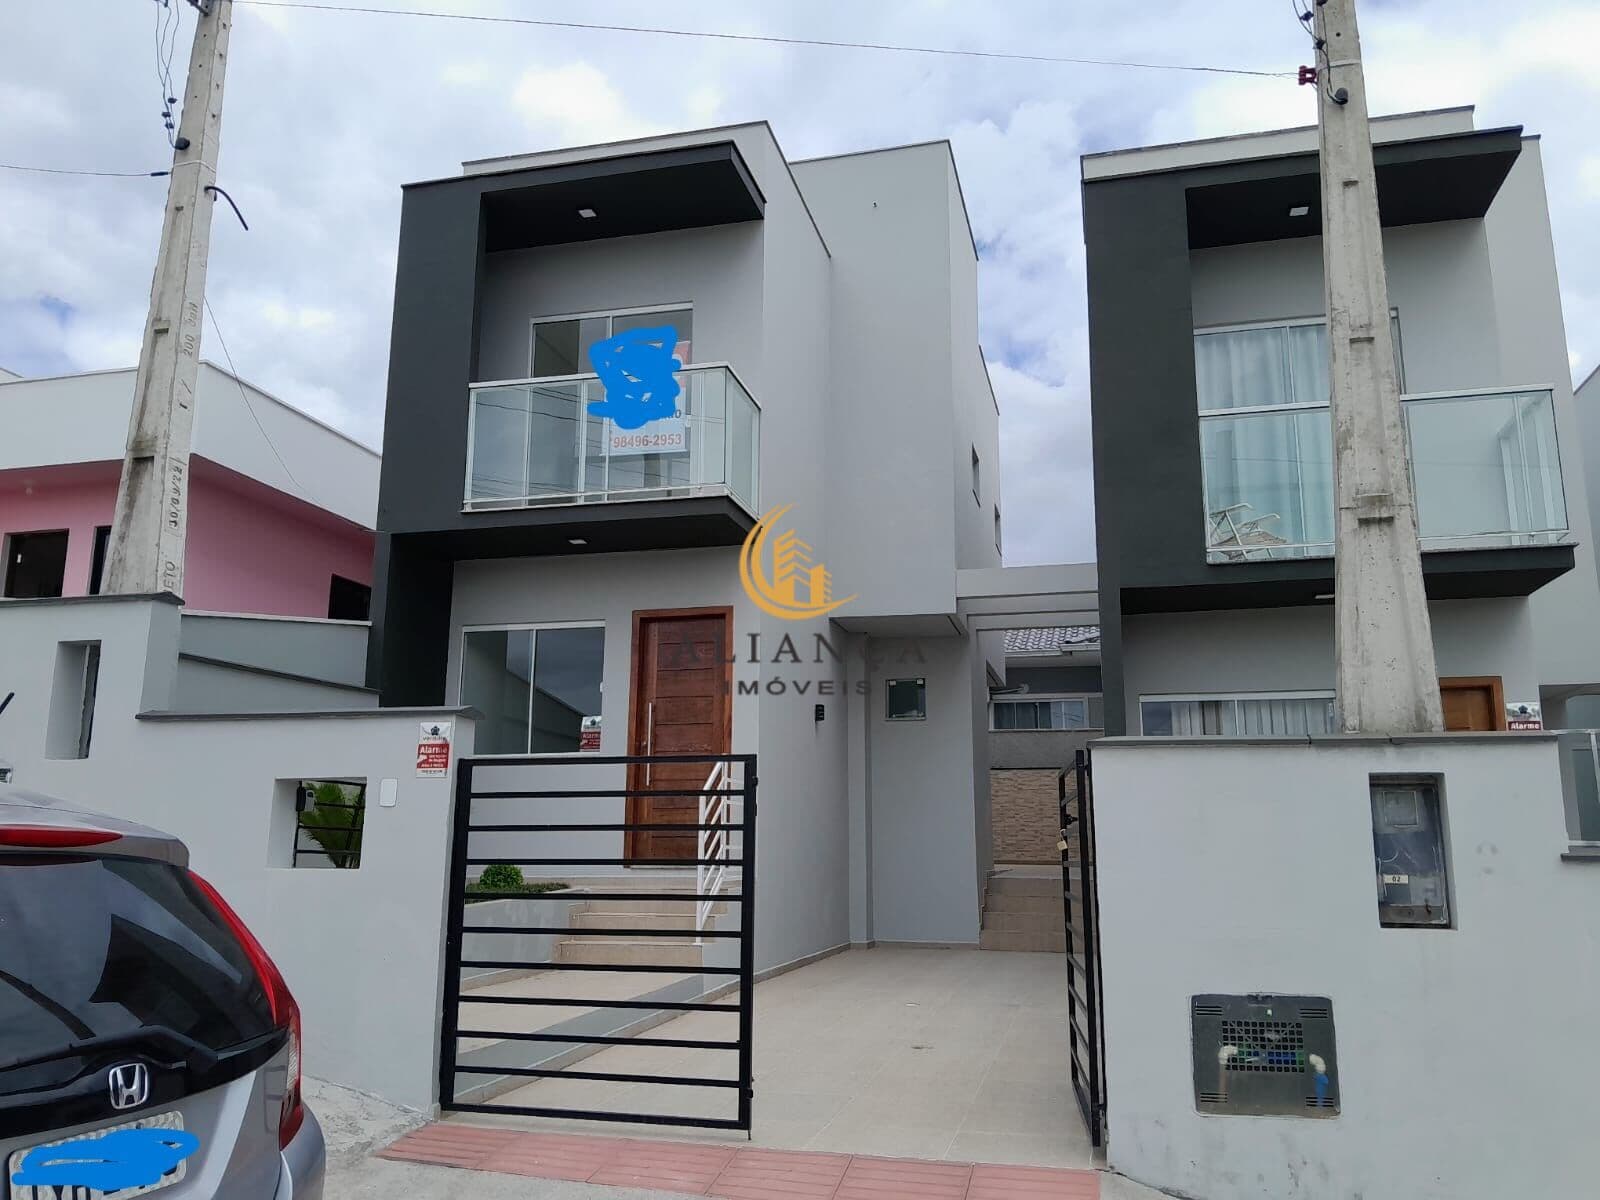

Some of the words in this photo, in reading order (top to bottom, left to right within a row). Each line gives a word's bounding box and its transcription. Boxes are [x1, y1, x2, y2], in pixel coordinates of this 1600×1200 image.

[613, 433, 682, 449] 98496-2953
[163, 560, 177, 593] ETO
[1510, 721, 1540, 730] Alarme
